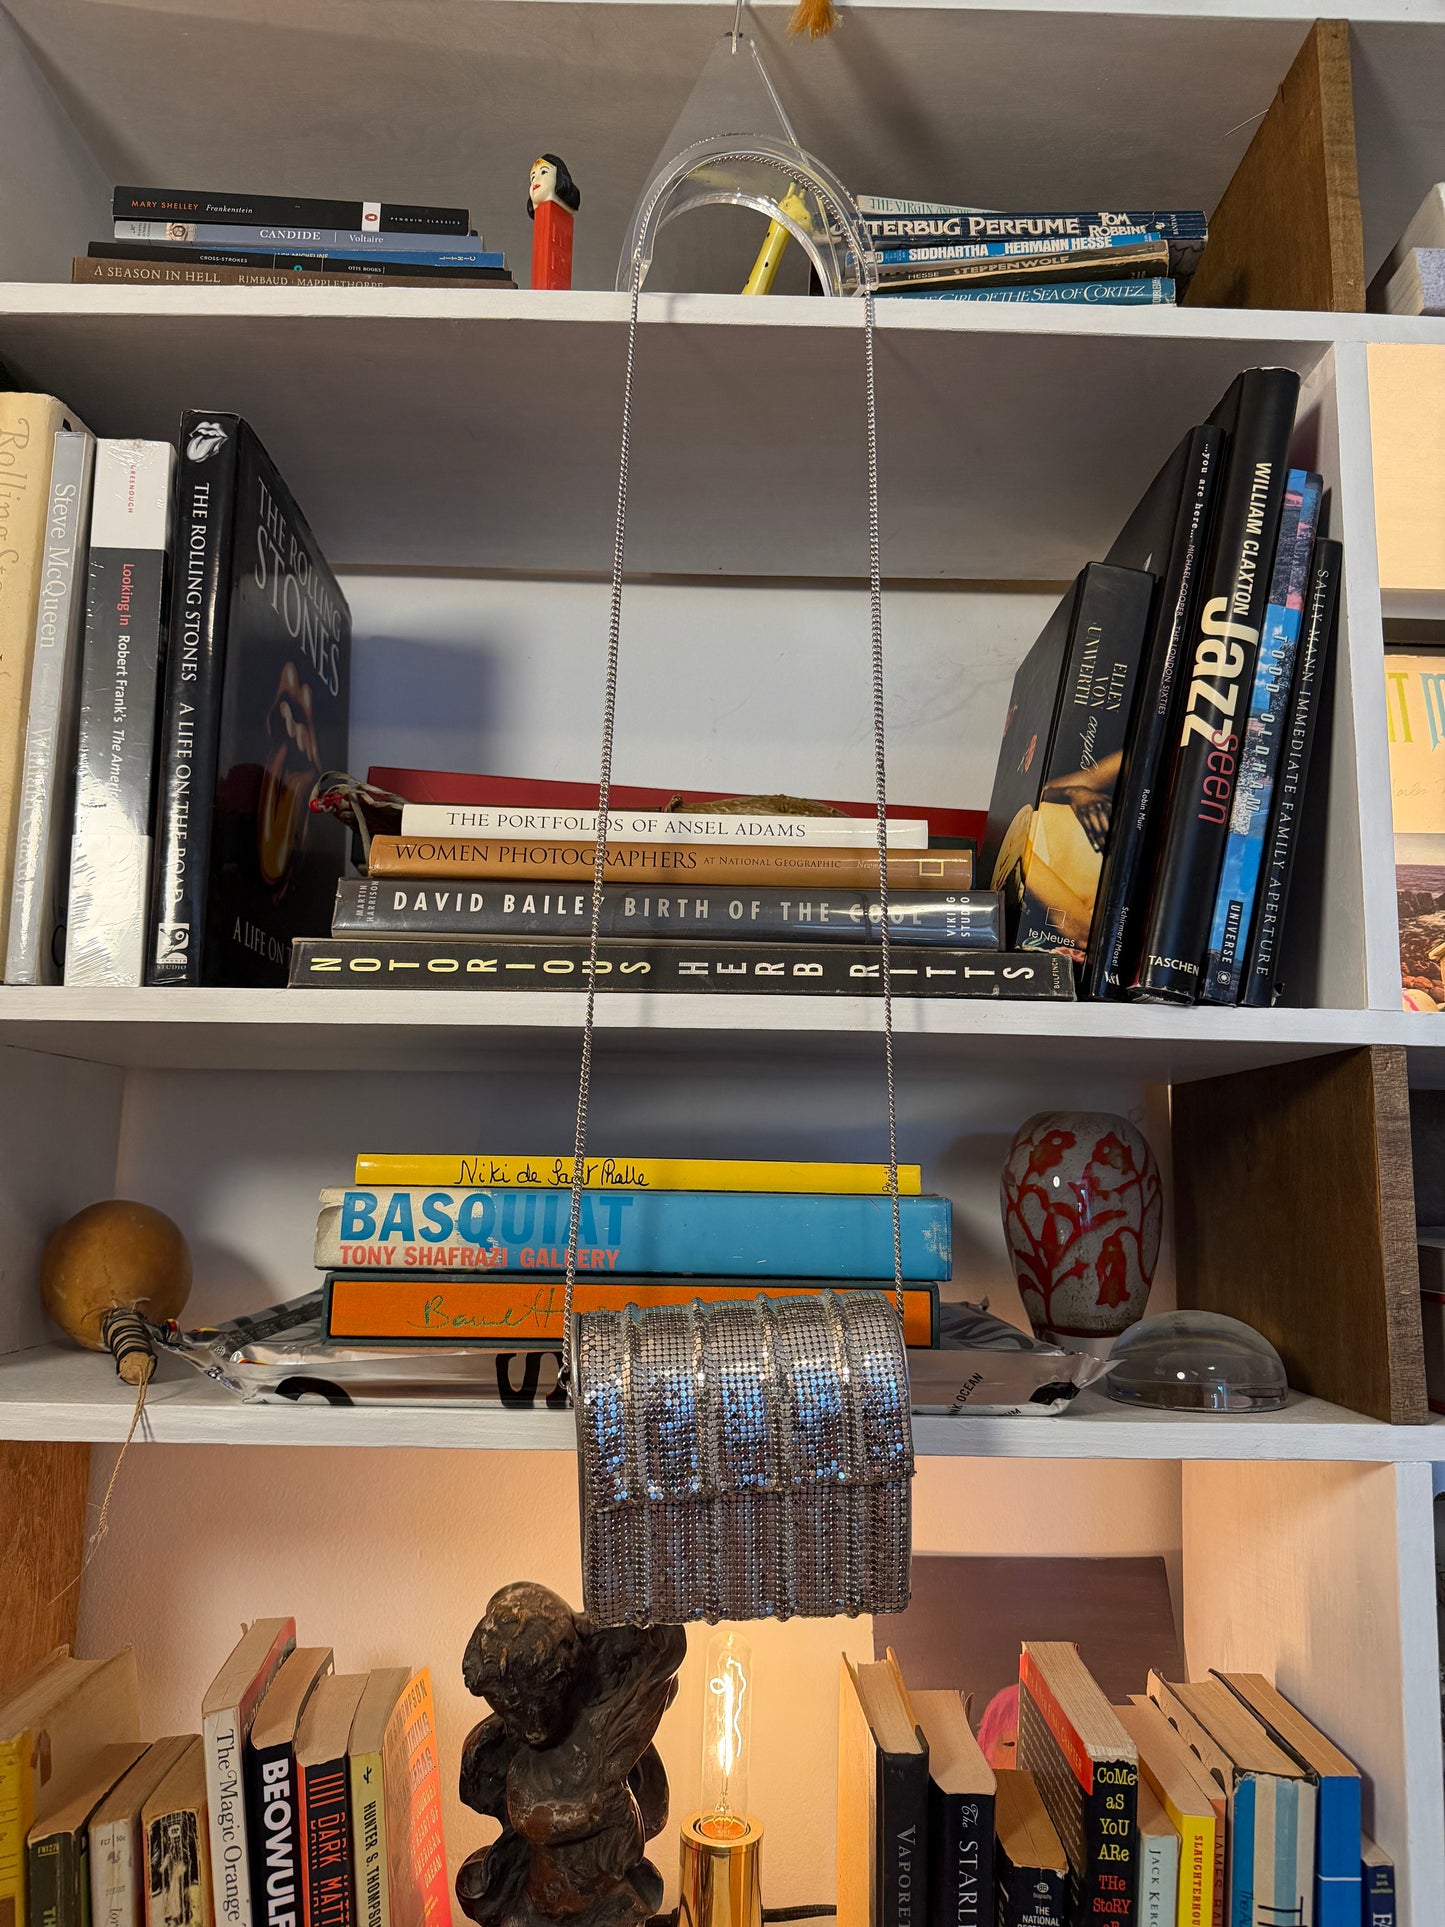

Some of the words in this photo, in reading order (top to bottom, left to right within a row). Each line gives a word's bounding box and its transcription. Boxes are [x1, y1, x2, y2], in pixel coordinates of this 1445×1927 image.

[131, 200, 157, 209] MARY
[161, 202, 199, 210] SHELLEY
[206, 204, 253, 214] Frankenstein
[870, 198, 893, 212] THE
[895, 200, 933, 214] VIRGIN
[969, 217, 1080, 236] PERFUME
[1098, 212, 1132, 226] TOM
[260, 229, 321, 241] CANDIDE
[349, 234, 384, 244] Voltaire
[909, 244, 989, 261] SIDDHARTHA
[1004, 238, 1069, 254] HERMANN
[1071, 236, 1112, 249] HESSE
[1088, 225, 1146, 237] ROBBINS
[94, 266, 103, 276] A
[108, 267, 161, 280] SEASON
[165, 270, 181, 281] IN
[185, 272, 221, 283] HELL
[238, 275, 288, 286] RIMBAUD
[297, 277, 383, 288] MAPPLETHORPE
[200, 255, 247, 264] CROSS-STROKES
[908, 271, 940, 280] HESSE
[953, 256, 1069, 275] STEPPENWOLF
[1032, 287, 1059, 302] SEA
[1061, 288, 1084, 300] OF
[1084, 284, 1146, 302] CORTEZ
[127, 464, 137, 514] GREENOUGH
[192, 482, 210, 519] THE
[1196, 479, 1206, 497] are
[1245, 463, 1273, 535] WILLIAM
[50, 483, 77, 539] Steve
[257, 476, 287, 553] THE
[186, 524, 208, 606] ROLLING
[1233, 540, 1261, 616] CLAXTON
[40, 548, 70, 649] McQueen
[116, 563, 135, 611] Looking
[289, 538, 341, 643] ROLLING
[1311, 569, 1330, 622] SALLY
[119, 613, 130, 627] In
[254, 525, 340, 697] STONES
[117, 634, 131, 677] Robert
[181, 609, 201, 682] STONES
[1074, 626, 1102, 706] UNWERTH
[1265, 634, 1288, 694] TODD
[1301, 629, 1322, 683] MANN
[1090, 675, 1109, 709] VON
[1106, 662, 1128, 713] ELLEN
[1180, 597, 1260, 752] Jazz
[113, 679, 129, 729] Frank's
[179, 702, 195, 715] A
[1158, 684, 1171, 716] SIXTIES
[111, 730, 125, 752] The
[175, 721, 194, 759] LIFE
[1080, 715, 1099, 772] couples
[1283, 690, 1312, 795] IMMEDIATE
[175, 764, 192, 796] ON
[1197, 729, 1239, 825] seen
[1247, 712, 1275, 813] OLDHAM
[1139, 788, 1151, 811] Robin
[174, 801, 190, 841] THE
[446, 812, 490, 827] THE
[632, 819, 658, 833] OF
[665, 820, 728, 836] ANSEL
[736, 822, 806, 838] ADAMS
[1135, 813, 1146, 831] Muir
[1272, 801, 1294, 870] FAMILY
[396, 843, 489, 863] WOMEN
[499, 846, 697, 869] PHOTOGRAPHERS
[703, 856, 715, 866] AT
[719, 855, 771, 868] NATIONAL
[774, 857, 841, 869] GEOGRAPHIC
[356, 884, 368, 919] MARTIN
[366, 880, 380, 922] HARRISON
[393, 891, 484, 912] DAVID
[624, 897, 710, 919] BIRTH
[729, 901, 760, 920] OF
[781, 901, 830, 922] THE
[849, 902, 922, 925] COOL
[946, 895, 957, 937] VIKIG
[960, 895, 972, 938] STUDO
[232, 917, 241, 941] A
[242, 919, 266, 957] LIFE
[268, 936, 286, 964] ON
[1112, 905, 1129, 967] Schirmer/Mosel
[1221, 904, 1241, 964] UNIVERSE
[1256, 877, 1282, 977] APERTURE
[310, 957, 652, 976] NOTORIOUS
[678, 961, 824, 977] HERB
[849, 963, 1035, 981] RITTS
[1052, 957, 1061, 989] BULFINCH
[1149, 955, 1199, 976] TASCHEN
[454, 1158, 511, 1184] Niki
[516, 1163, 542, 1184] de
[548, 1159, 599, 1186] Sat
[600, 1159, 650, 1186] Phalle
[340, 1191, 634, 1253] BASQUIAT
[340, 1245, 397, 1266] TONY
[404, 1246, 508, 1268] SHAFRAZI
[956, 1372, 984, 1402] OCEAN
[217, 1728, 235, 1770] The
[1097, 1767, 1136, 1785] CoMe
[217, 1770, 240, 1842] Magic
[961, 1803, 979, 1828] The
[1105, 1794, 1125, 1810] aS
[262, 1758, 297, 1927] BEOWULF
[313, 1811, 344, 1868] DARK
[364, 1801, 379, 1851] HUNTER
[366, 1852, 379, 1867] S.
[1097, 1844, 1129, 1862] ARe
[1149, 1850, 1161, 1886] JACK
[223, 1845, 243, 1922] Orange
[315, 1874, 346, 1927] MATT
[367, 1868, 382, 1927] THOMPSO
[1192, 1835, 1203, 1927] SLAUGHTERHOU
[1022, 1914, 1061, 1927] NATIONAL
[1035, 1905, 1050, 1916] THE
